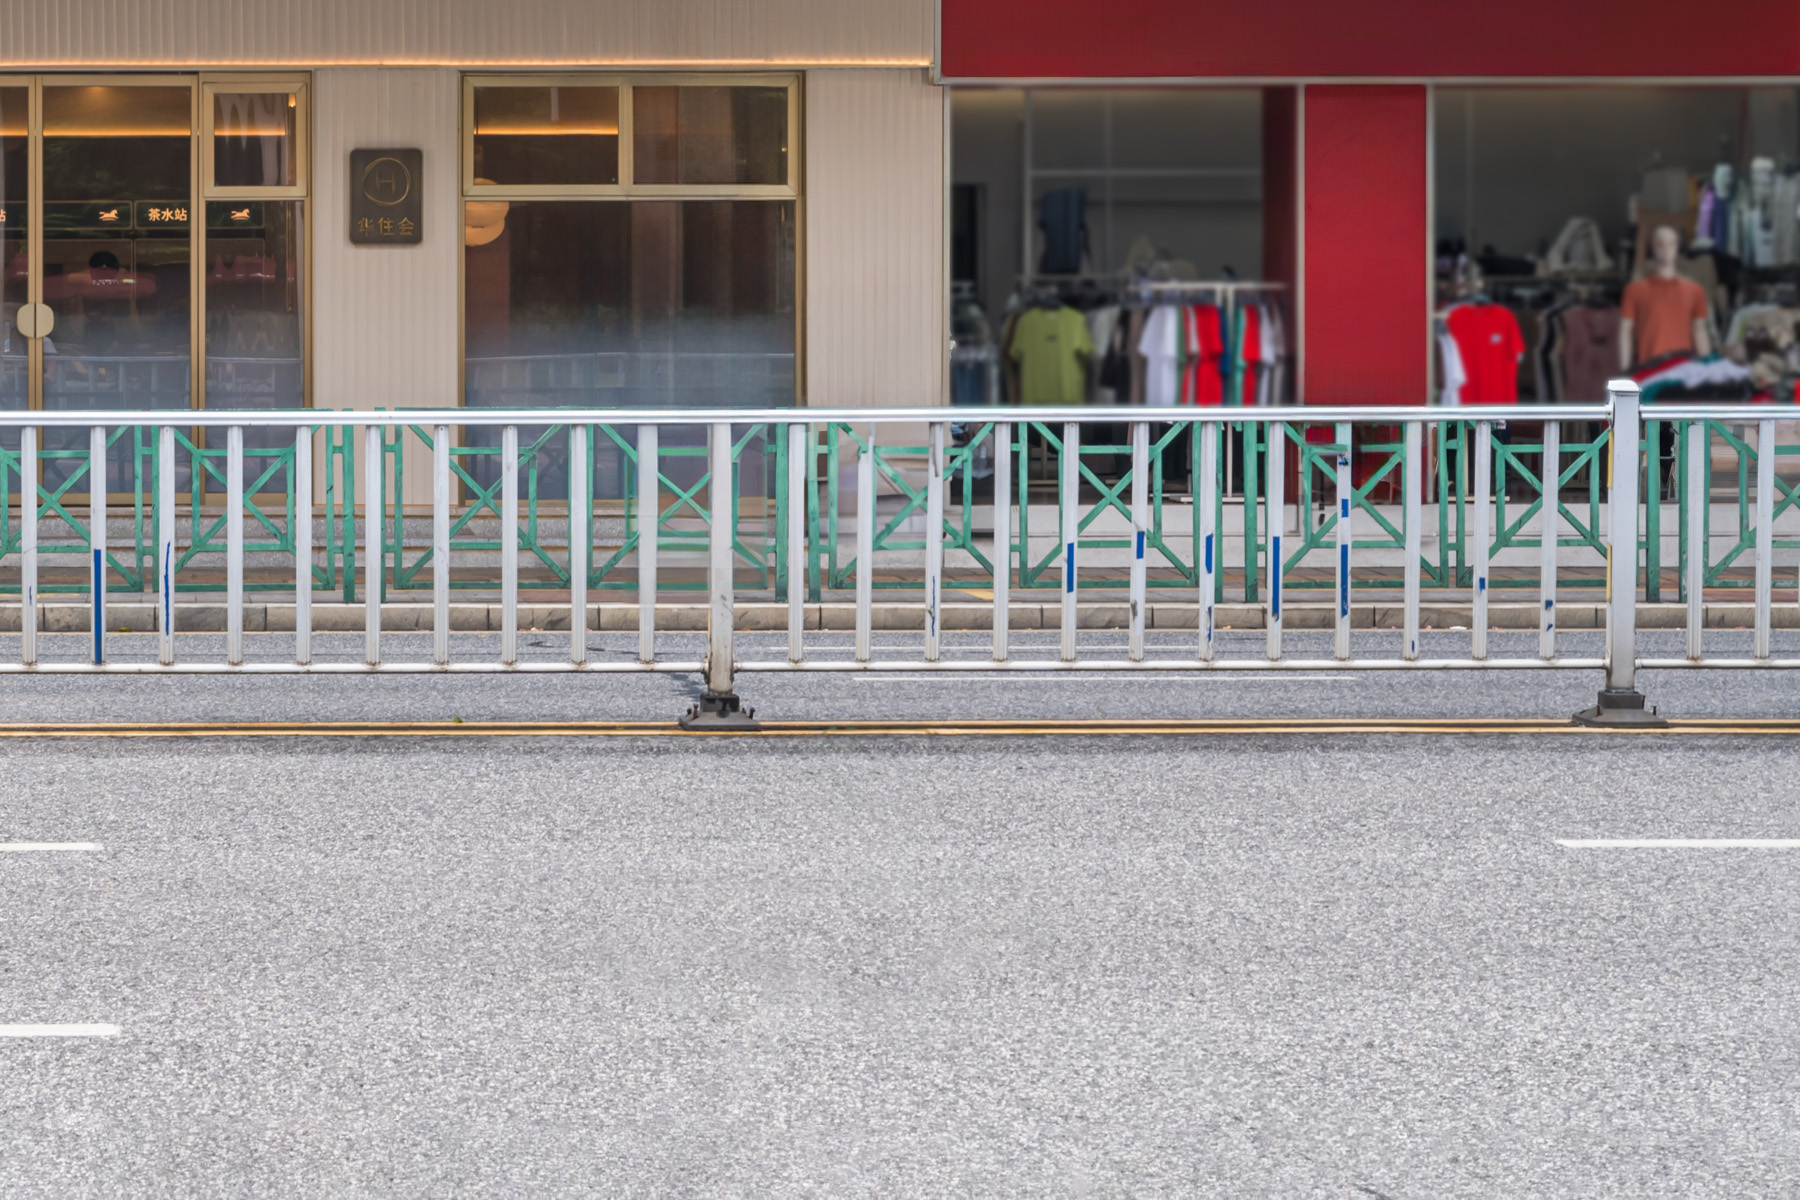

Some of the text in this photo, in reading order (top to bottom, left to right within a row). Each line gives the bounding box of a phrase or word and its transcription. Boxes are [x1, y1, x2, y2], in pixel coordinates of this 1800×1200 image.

[148, 207, 188, 222] 茶水站
[358, 216, 415, 237] 华住会
